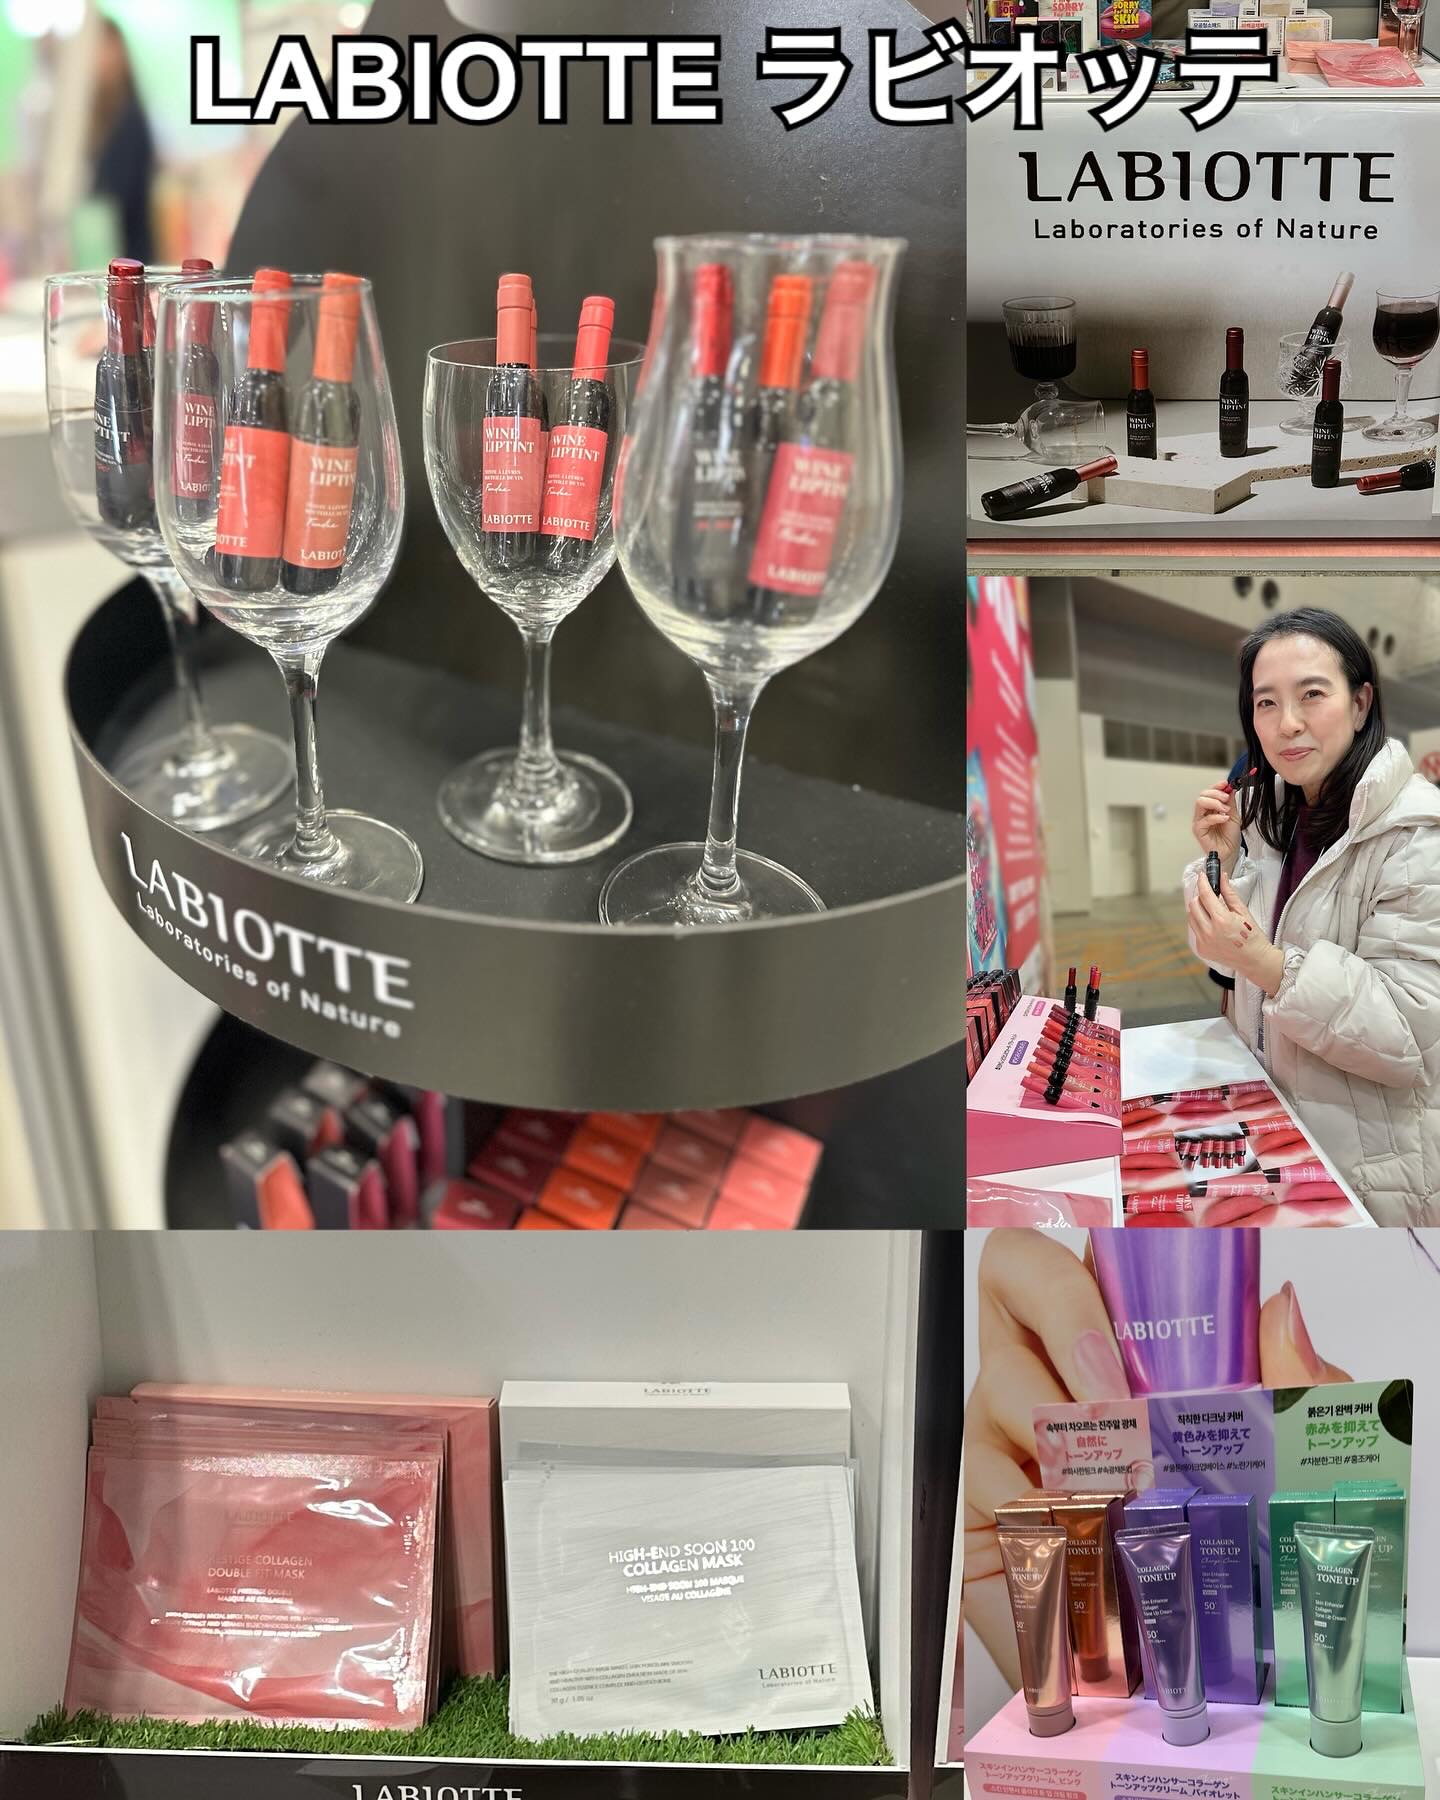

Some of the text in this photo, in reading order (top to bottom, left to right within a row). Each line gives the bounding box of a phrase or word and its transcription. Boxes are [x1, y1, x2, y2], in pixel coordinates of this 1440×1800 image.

[1052, 3, 1084, 12] SORRY
[1113, 1, 1139, 9] SORRY
[1113, 14, 1139, 24] SKIN
[1018, 150, 1395, 203] LABIOTTE
[1034, 217, 1379, 240] Laboratories of Nature
[485, 427, 520, 440] WINE
[552, 434, 587, 446] WINE
[486, 442, 534, 454] LIPTINT
[551, 447, 600, 463] LIPTINT
[311, 456, 352, 472] WINE
[483, 513, 533, 525] LABIOTTE
[542, 516, 590, 532] LABIOTTE
[121, 831, 415, 1010] LABIOTTE
[136, 891, 401, 1039] Laboratories of Nature
[1114, 1314, 1216, 1341] LABIOTTE
[1308, 1402, 1373, 1418] 붉은기 완벽 커버
[1178, 1410, 1244, 1426] 칙칙한 다크닝 커버
[1069, 1421, 1098, 1432] 차오르는
[1122, 1418, 1137, 1430] 광채
[1306, 1419, 1380, 1436] 赤みを抑えて
[1076, 1435, 1108, 1448] 自然に
[1172, 1428, 1251, 1444] 黄色みを抑えて
[1308, 1435, 1379, 1451] トーンアップ
[1065, 1448, 1122, 1462] トーンアップ
[1181, 1443, 1244, 1457] トーンアップ
[1300, 1456, 1342, 1466] #차분한그린
[1200, 1538, 1234, 1546] COLLAGEN
[1378, 1544, 1393, 1553] UP
[608, 1538, 756, 1564] HIGH-END SOON 100
[1067, 1547, 1104, 1556] TONE UP
[1200, 1547, 1241, 1556] TONE UP
[256, 1554, 313, 1566] COLLAGEN
[622, 1554, 744, 1578] COLLAGEN MASK
[208, 1568, 252, 1578] DOUBLE
[274, 1569, 305, 1580] MASK
[1136, 1564, 1170, 1574] COLLAGEN
[1316, 1564, 1354, 1575] COLLAGEN
[1137, 1572, 1176, 1584] TONE UP
[1316, 1573, 1360, 1586] TONE UP
[671, 1592, 684, 1601] AU
[1314, 1606, 1332, 1614] Collagen
[758, 1663, 838, 1680] LABIOTTE
[1116, 1772, 1230, 1790] スキンインハンサーコラーゲン
